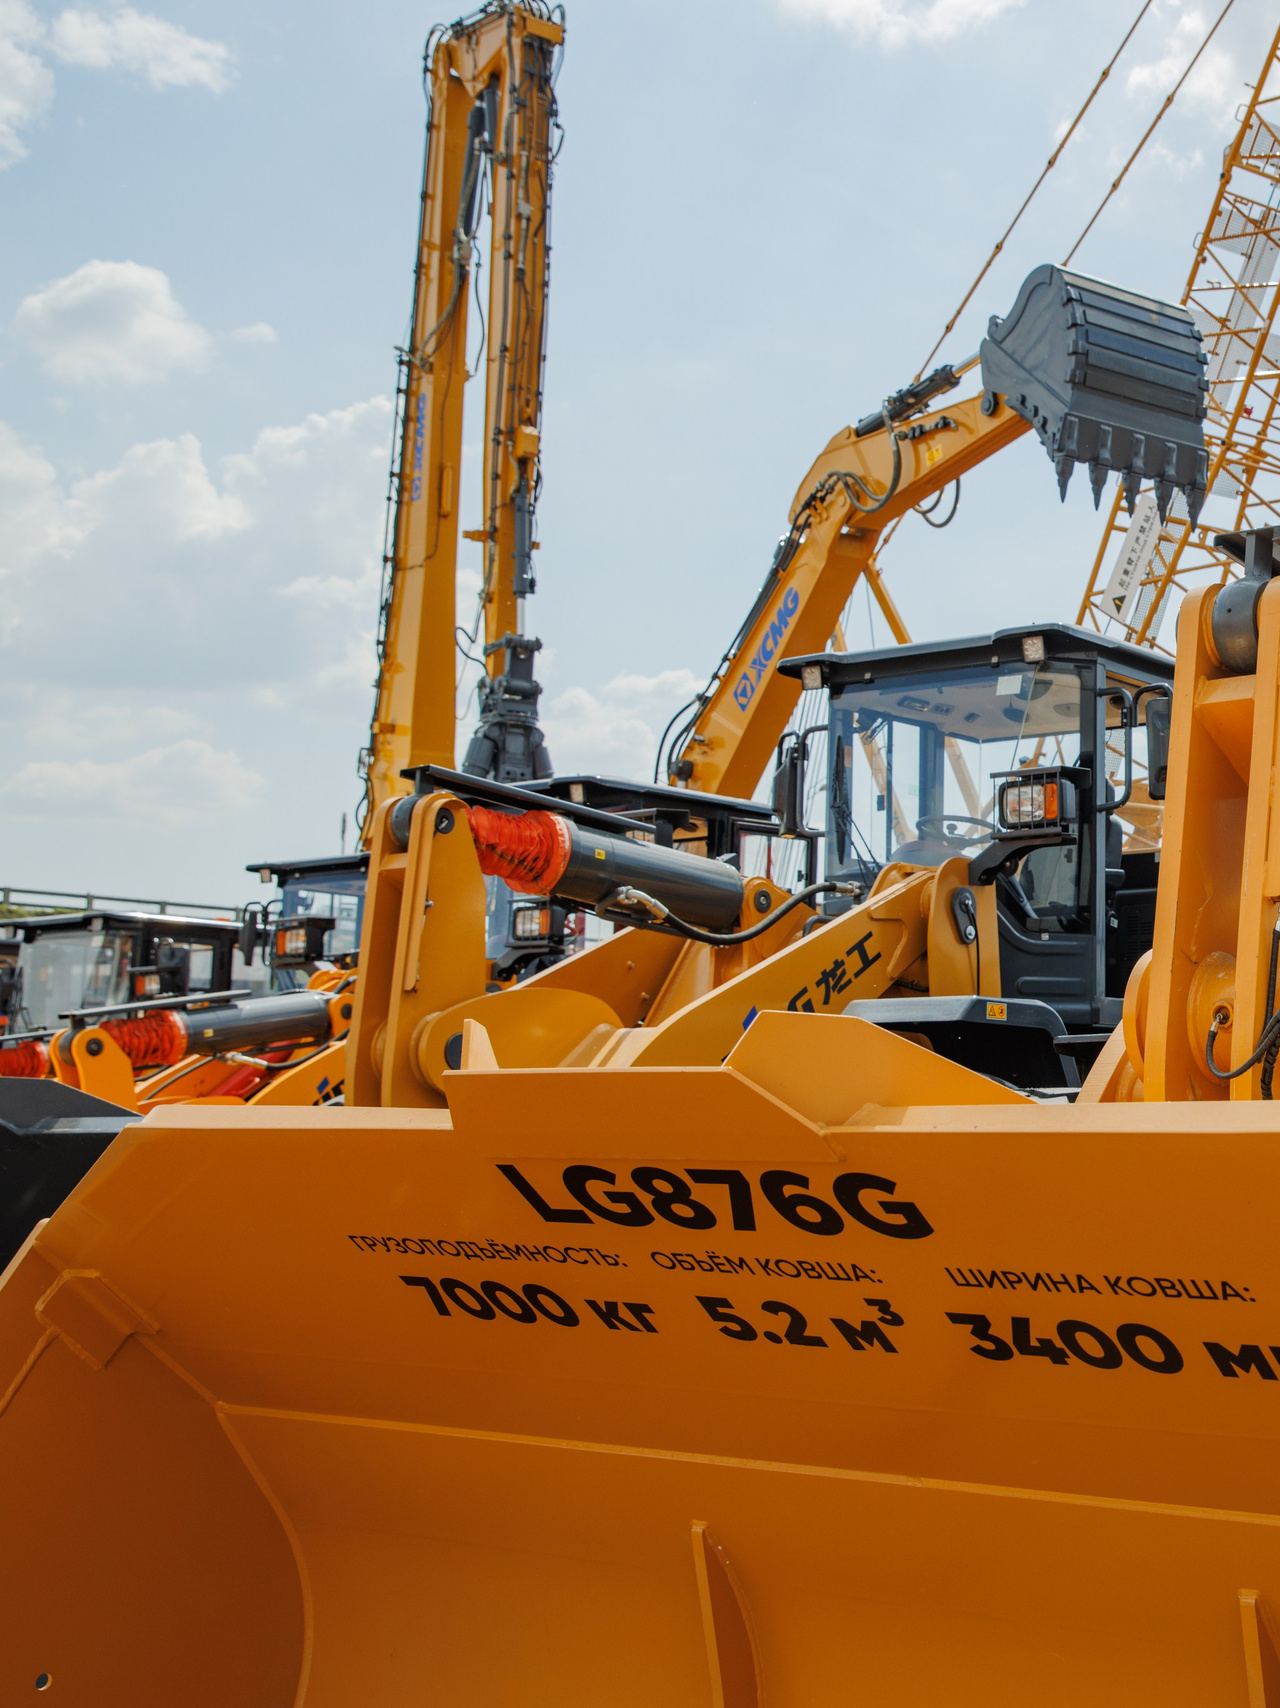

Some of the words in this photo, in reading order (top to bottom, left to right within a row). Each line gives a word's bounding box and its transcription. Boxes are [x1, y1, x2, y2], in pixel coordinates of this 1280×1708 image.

[749, 586, 799, 688] XCMG
[495, 1164, 935, 1240] LG876G
[347, 1235, 628, 1268] ГРУЗОПОДЪЁМНОСТЬ:
[650, 1251, 756, 1276] ОБЪЁМ
[755, 1258, 884, 1284] КОВША:
[398, 1275, 580, 1328] 7000
[583, 1299, 659, 1334] кг
[944, 1267, 1102, 1295] ШИРИНА
[1103, 1275, 1256, 1303] КОВША:
[695, 1295, 829, 1348] 5.2
[944, 1312, 1184, 1375] 3400
